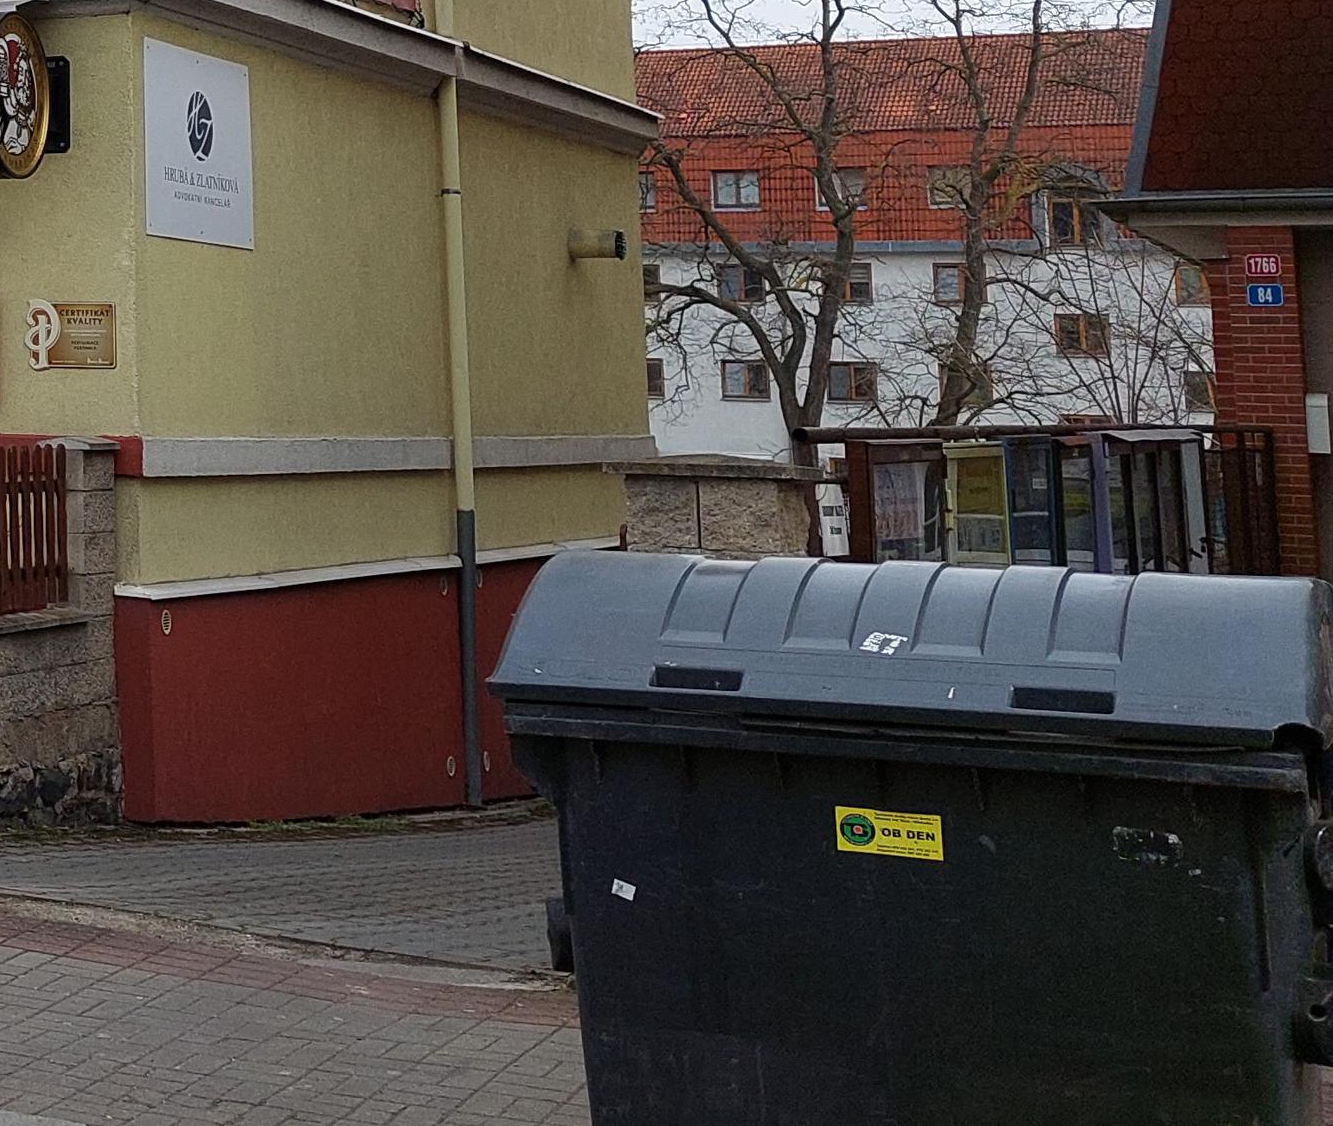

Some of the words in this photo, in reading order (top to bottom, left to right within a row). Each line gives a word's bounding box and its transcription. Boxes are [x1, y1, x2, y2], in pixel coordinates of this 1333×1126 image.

[1248, 257, 1277, 273] 1766
[1257, 287, 1273, 303] 84
[881, 827, 902, 838] OB
[906, 829, 936, 842] DEN
